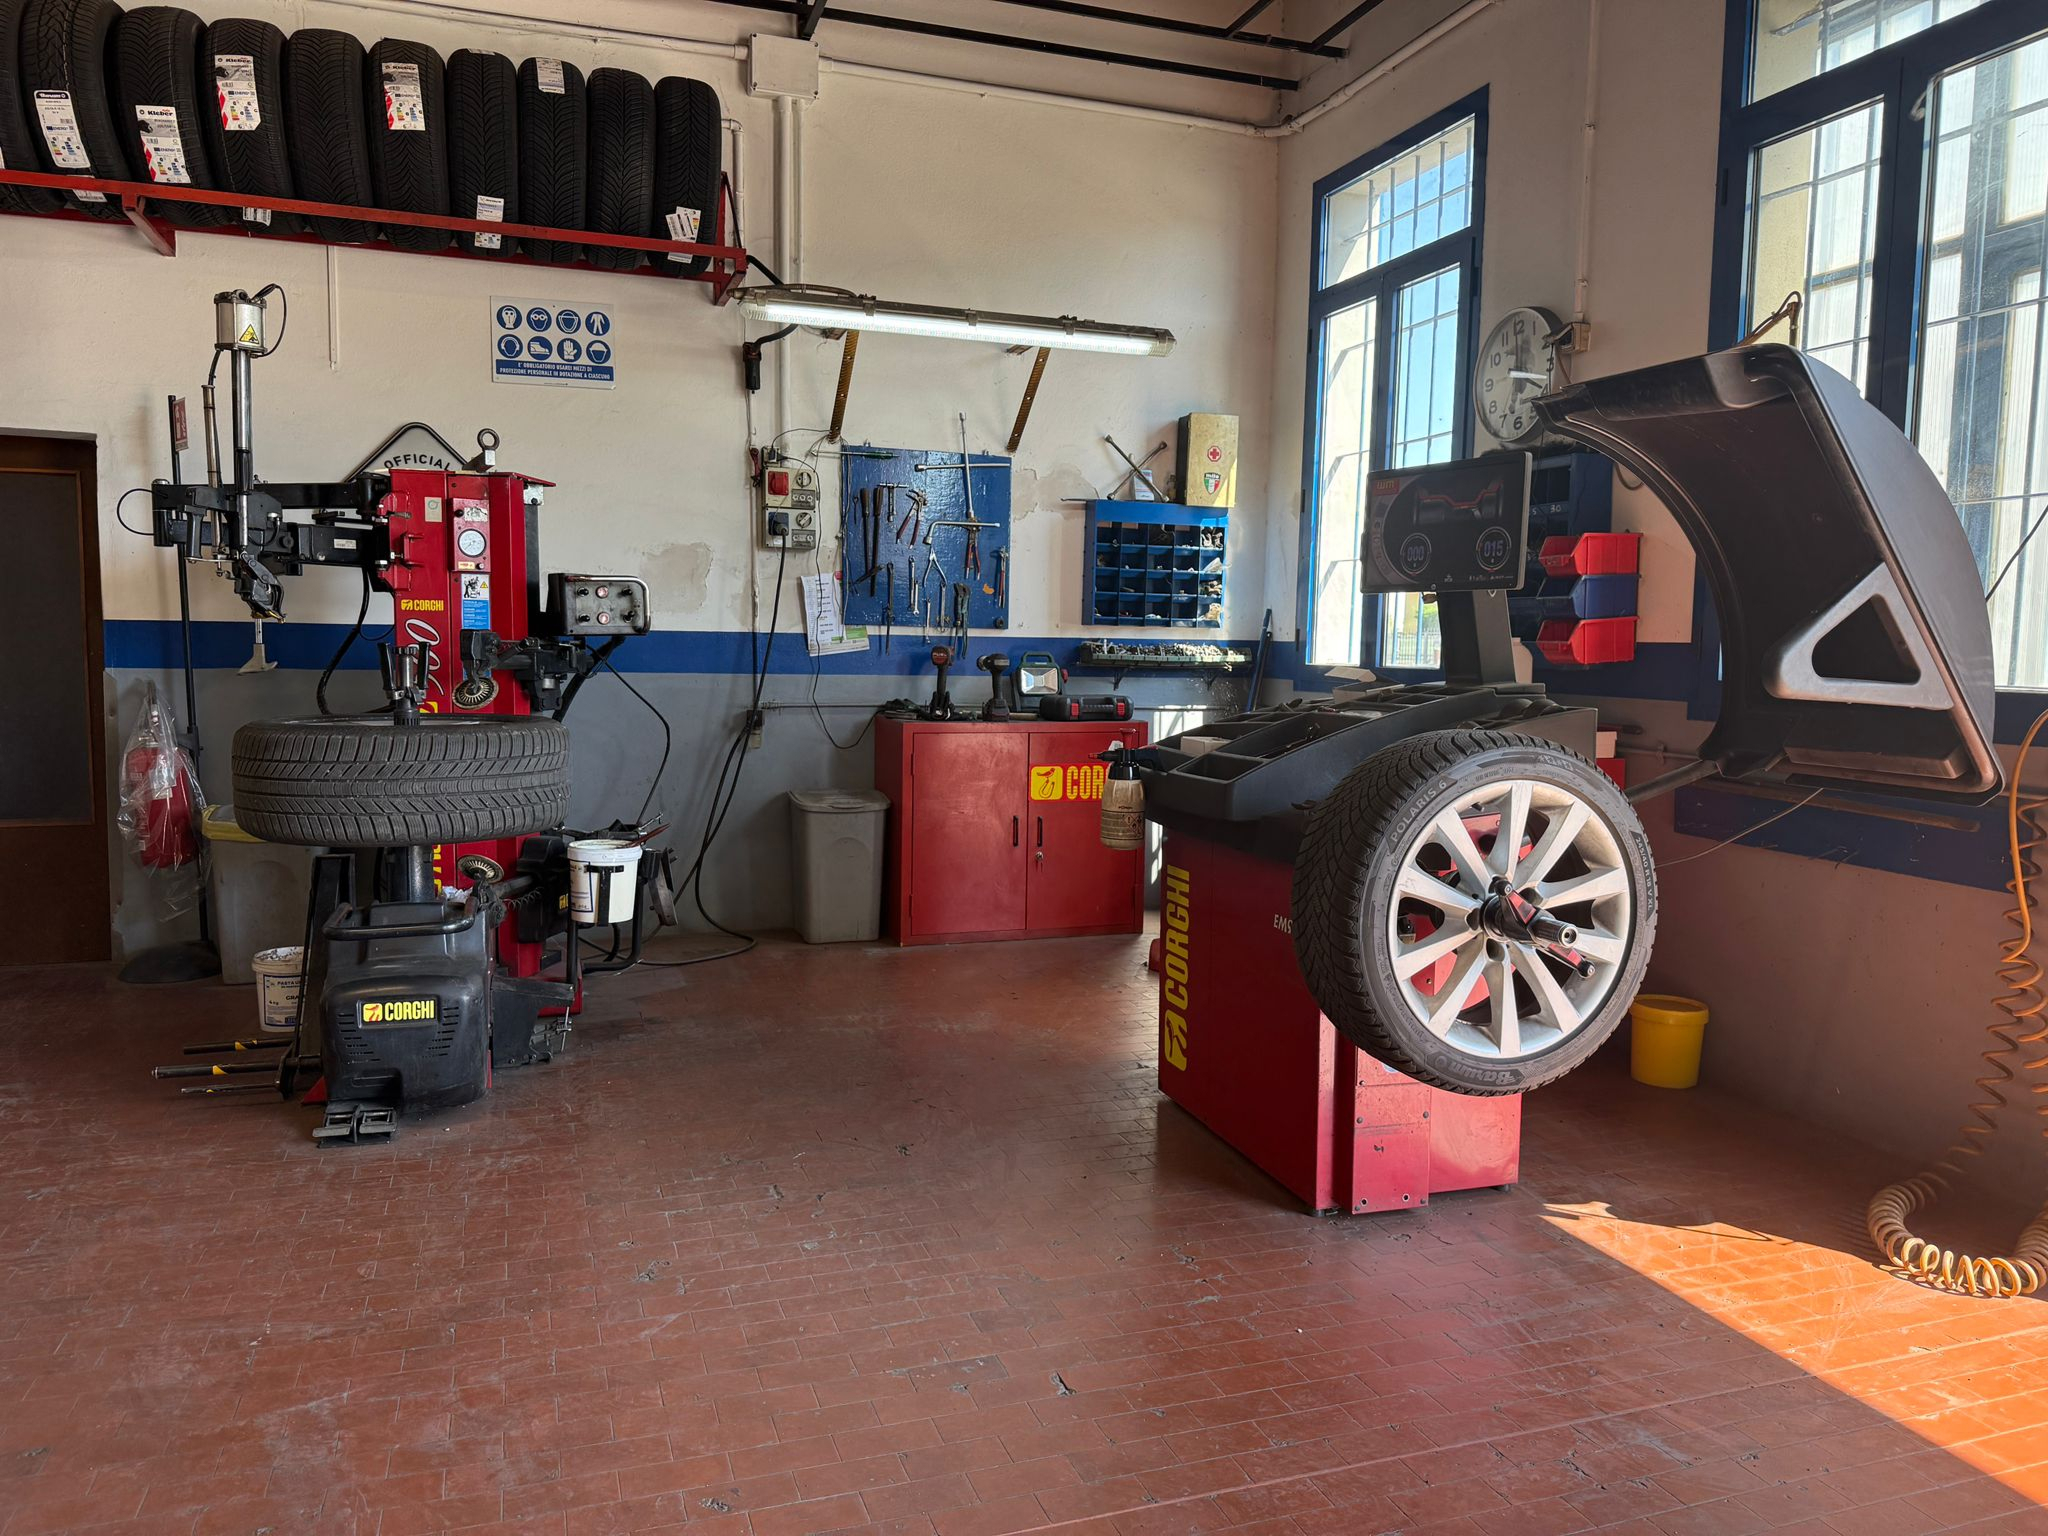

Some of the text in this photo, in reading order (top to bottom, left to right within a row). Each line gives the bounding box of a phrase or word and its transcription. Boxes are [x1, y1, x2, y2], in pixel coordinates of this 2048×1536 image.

[1490, 352, 1501, 369] 10
[1485, 378, 1494, 393] 9
[1489, 400, 1498, 414] 8
[1499, 414, 1508, 429] 7
[1513, 416, 1523, 430] 6
[383, 453, 450, 471] OFFICIAL
[1407, 546, 1425, 561] 000
[1483, 540, 1504, 557] 015
[413, 599, 445, 611] CORGHI
[1066, 765, 1105, 800] COR
[1391, 779, 1447, 842] POLARIS 6
[1635, 837, 1649, 868] 245/40
[1164, 864, 1190, 1011] CORGHI
[384, 999, 435, 1021] CORGHI
[1448, 1062, 1516, 1085] Barum
